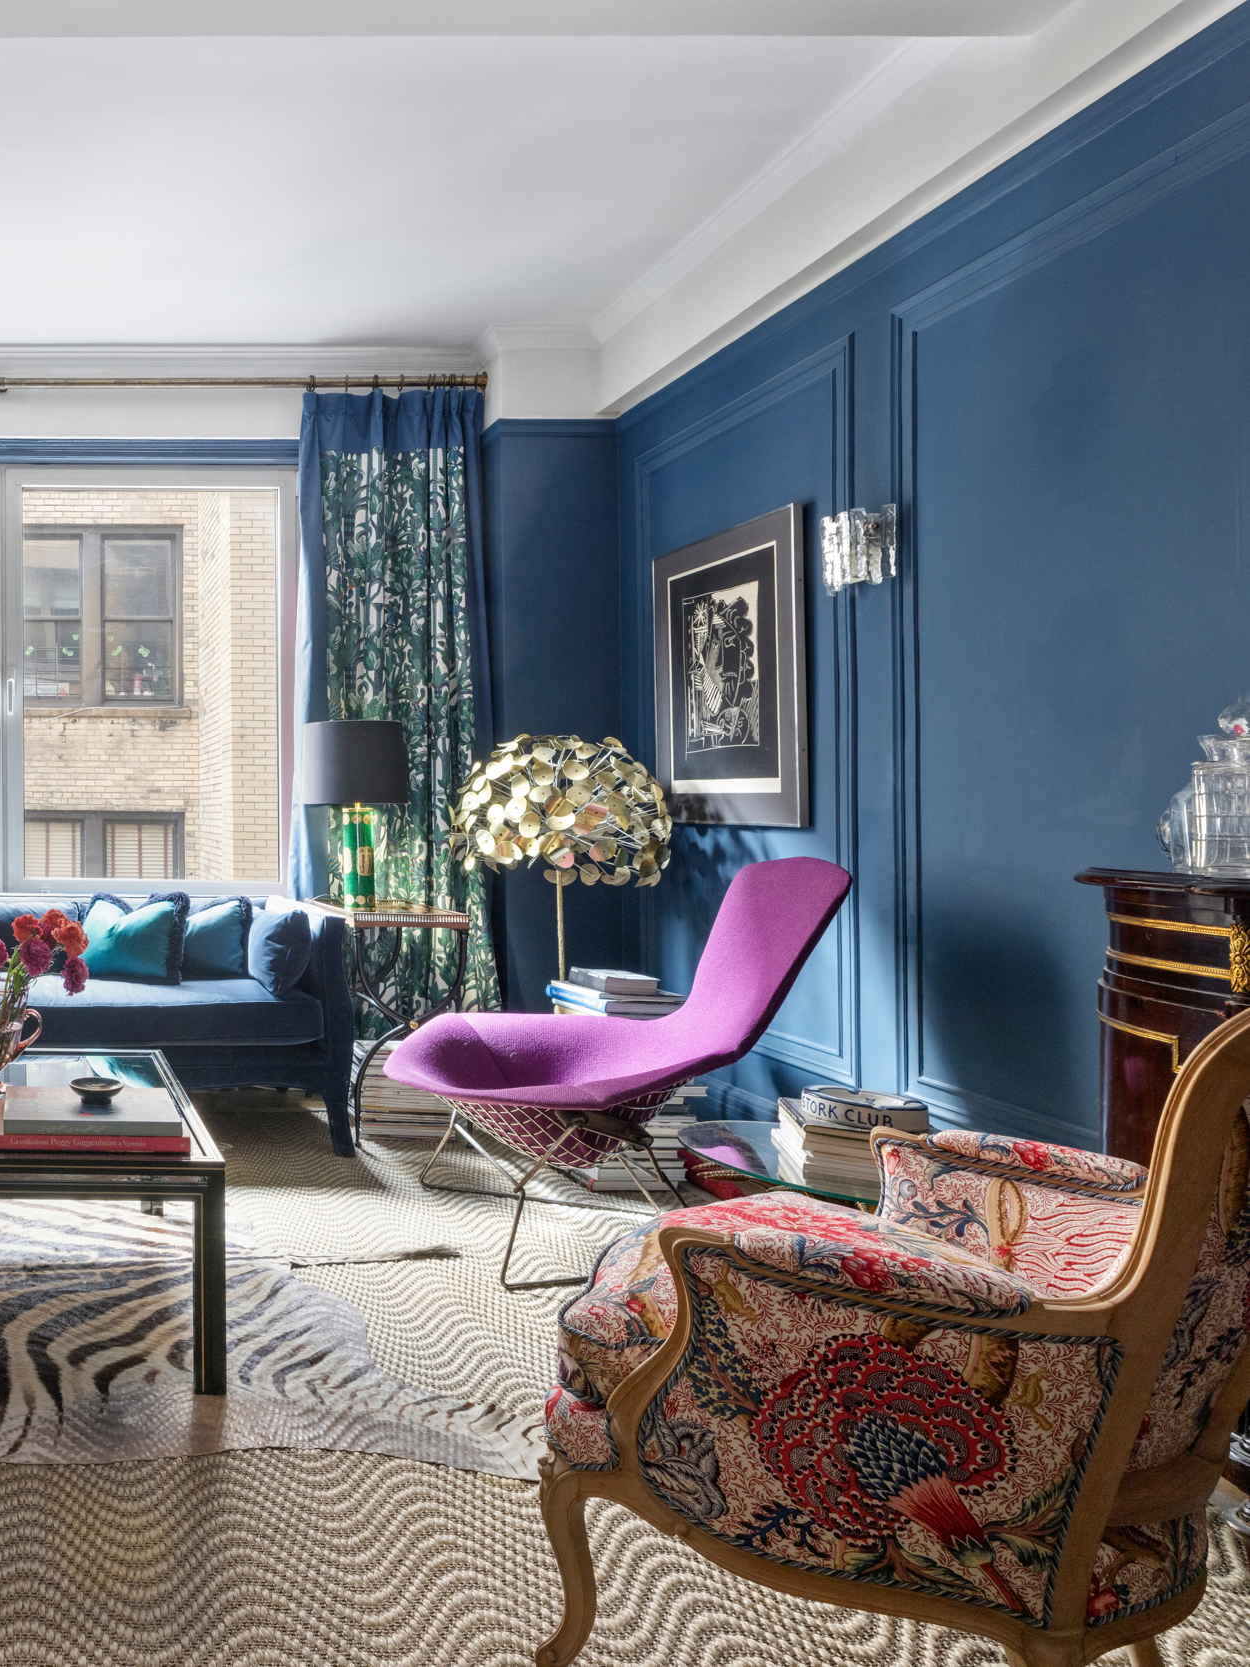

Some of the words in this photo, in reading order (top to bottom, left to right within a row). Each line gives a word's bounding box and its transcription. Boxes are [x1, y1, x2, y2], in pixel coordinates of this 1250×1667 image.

[802, 1095, 838, 1120] STORK
[844, 1108, 894, 1128] CLUB
[50, 1138, 72, 1148] Peggy
[73, 1138, 117, 1148] Guggenheim
